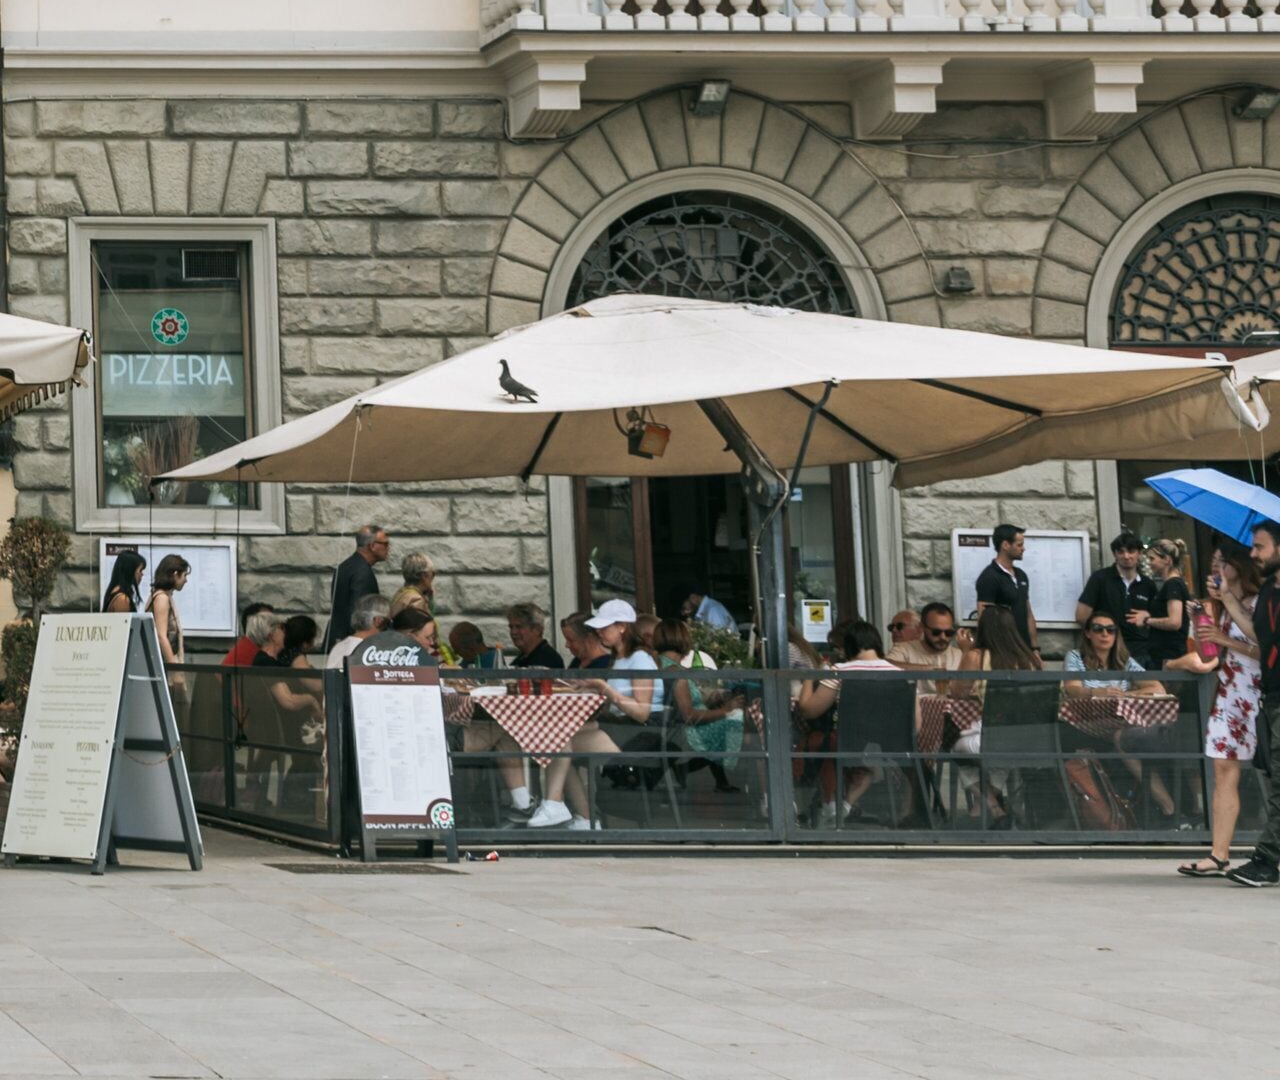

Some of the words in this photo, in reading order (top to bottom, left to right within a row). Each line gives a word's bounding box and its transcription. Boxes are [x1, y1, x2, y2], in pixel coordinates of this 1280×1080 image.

[109, 354, 235, 386] PIZZERIA
[55, 626, 85, 641] LUNCH
[86, 626, 111, 641] MENU
[362, 645, 421, 667] Coca-Cola
